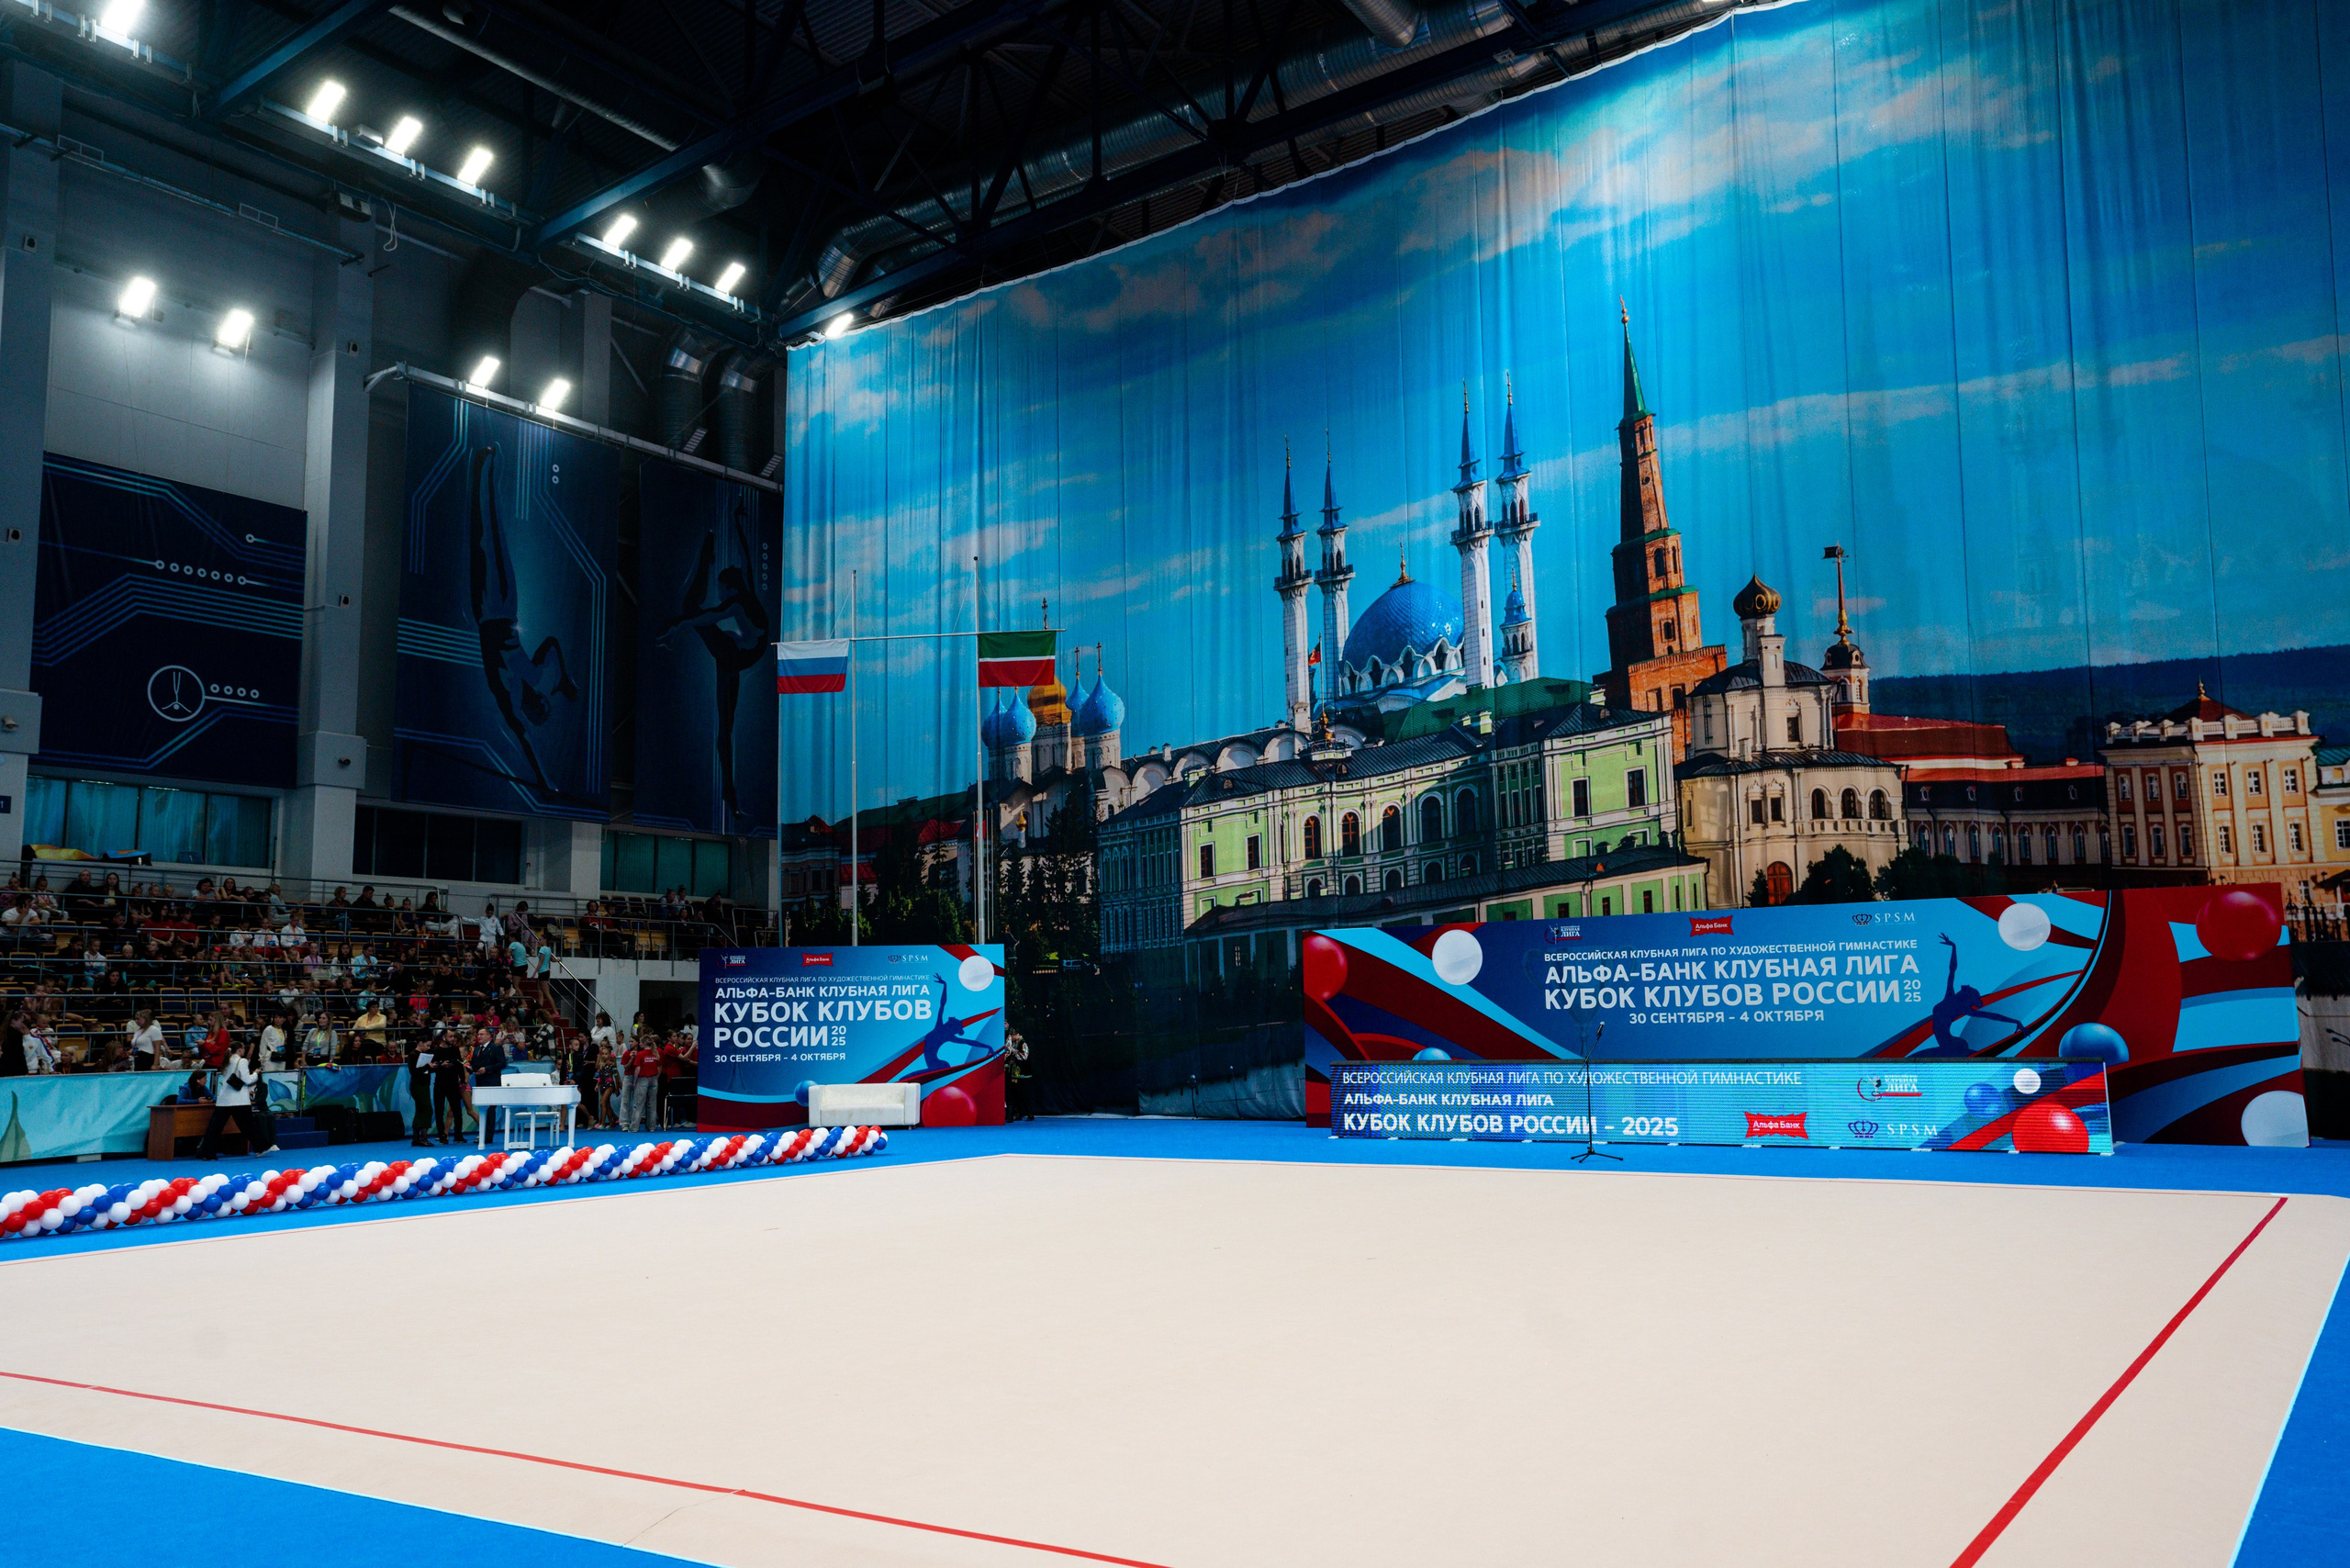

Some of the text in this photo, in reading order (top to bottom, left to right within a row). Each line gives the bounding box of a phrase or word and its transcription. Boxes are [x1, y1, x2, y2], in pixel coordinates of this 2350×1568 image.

[1544, 939, 1918, 962] ВСЕРОССИЙСКАЯ КЛУБНАЯ ЛИГА ПО ХУДОЖЕСТВЕННОЙ ГИМНАСТИКЕ
[1545, 954, 1919, 984] АЛЬФА-БАНК КЛУБНАЯ ЛИГА
[715, 976, 768, 984] ВСЕРОССИЙСКАЯ
[828, 974, 889, 982] ХУДОЖЕСТВЕННОЙ
[1903, 979, 1921, 991] 20
[715, 984, 930, 999] АЛЬФА-БАНК КЛУБНАЯ ЛИГА
[1545, 980, 1900, 1010] КУБОК КЛУБОВ РОССИИ
[1904, 991, 1921, 1002] 25
[714, 999, 932, 1024] КУБОК КЛУБОВ
[1628, 1013, 1647, 1025] 30
[1650, 1012, 1725, 1025] СЕНТЯБРЯ
[1740, 1011, 1750, 1022] 4
[1753, 1010, 1825, 1022] ОКТЯБРЯ
[714, 1025, 828, 1048] РОССИИ
[831, 1025, 846, 1036] 20
[831, 1036, 846, 1047] 25
[714, 1054, 727, 1063] 30
[730, 1053, 781, 1063] СЕНТЯБРЯ
[791, 1053, 798, 1061] 4
[800, 1052, 845, 1061] ОКТЯБРЯ
[1343, 1070, 1802, 1086] ВСЕРОССИЙСКАЯ КЛУБНАЯ ЛИГА ПО ХУДОЖЕСТВЕННОЙ ГИМНАСТИКЕ
[1885, 1083, 1919, 1092] ЛИГА
[1344, 1093, 1554, 1106] АЛЬФА-БАНК КЛУБНАЯ ЛИГА
[1344, 1113, 1411, 1131] КУБОК
[1417, 1114, 1504, 1133] КЛУБОВ
[1510, 1114, 1597, 1135] РОССИИ
[1621, 1116, 1679, 1137] 2025
[1753, 1120, 1800, 1129] Альфа Банк
